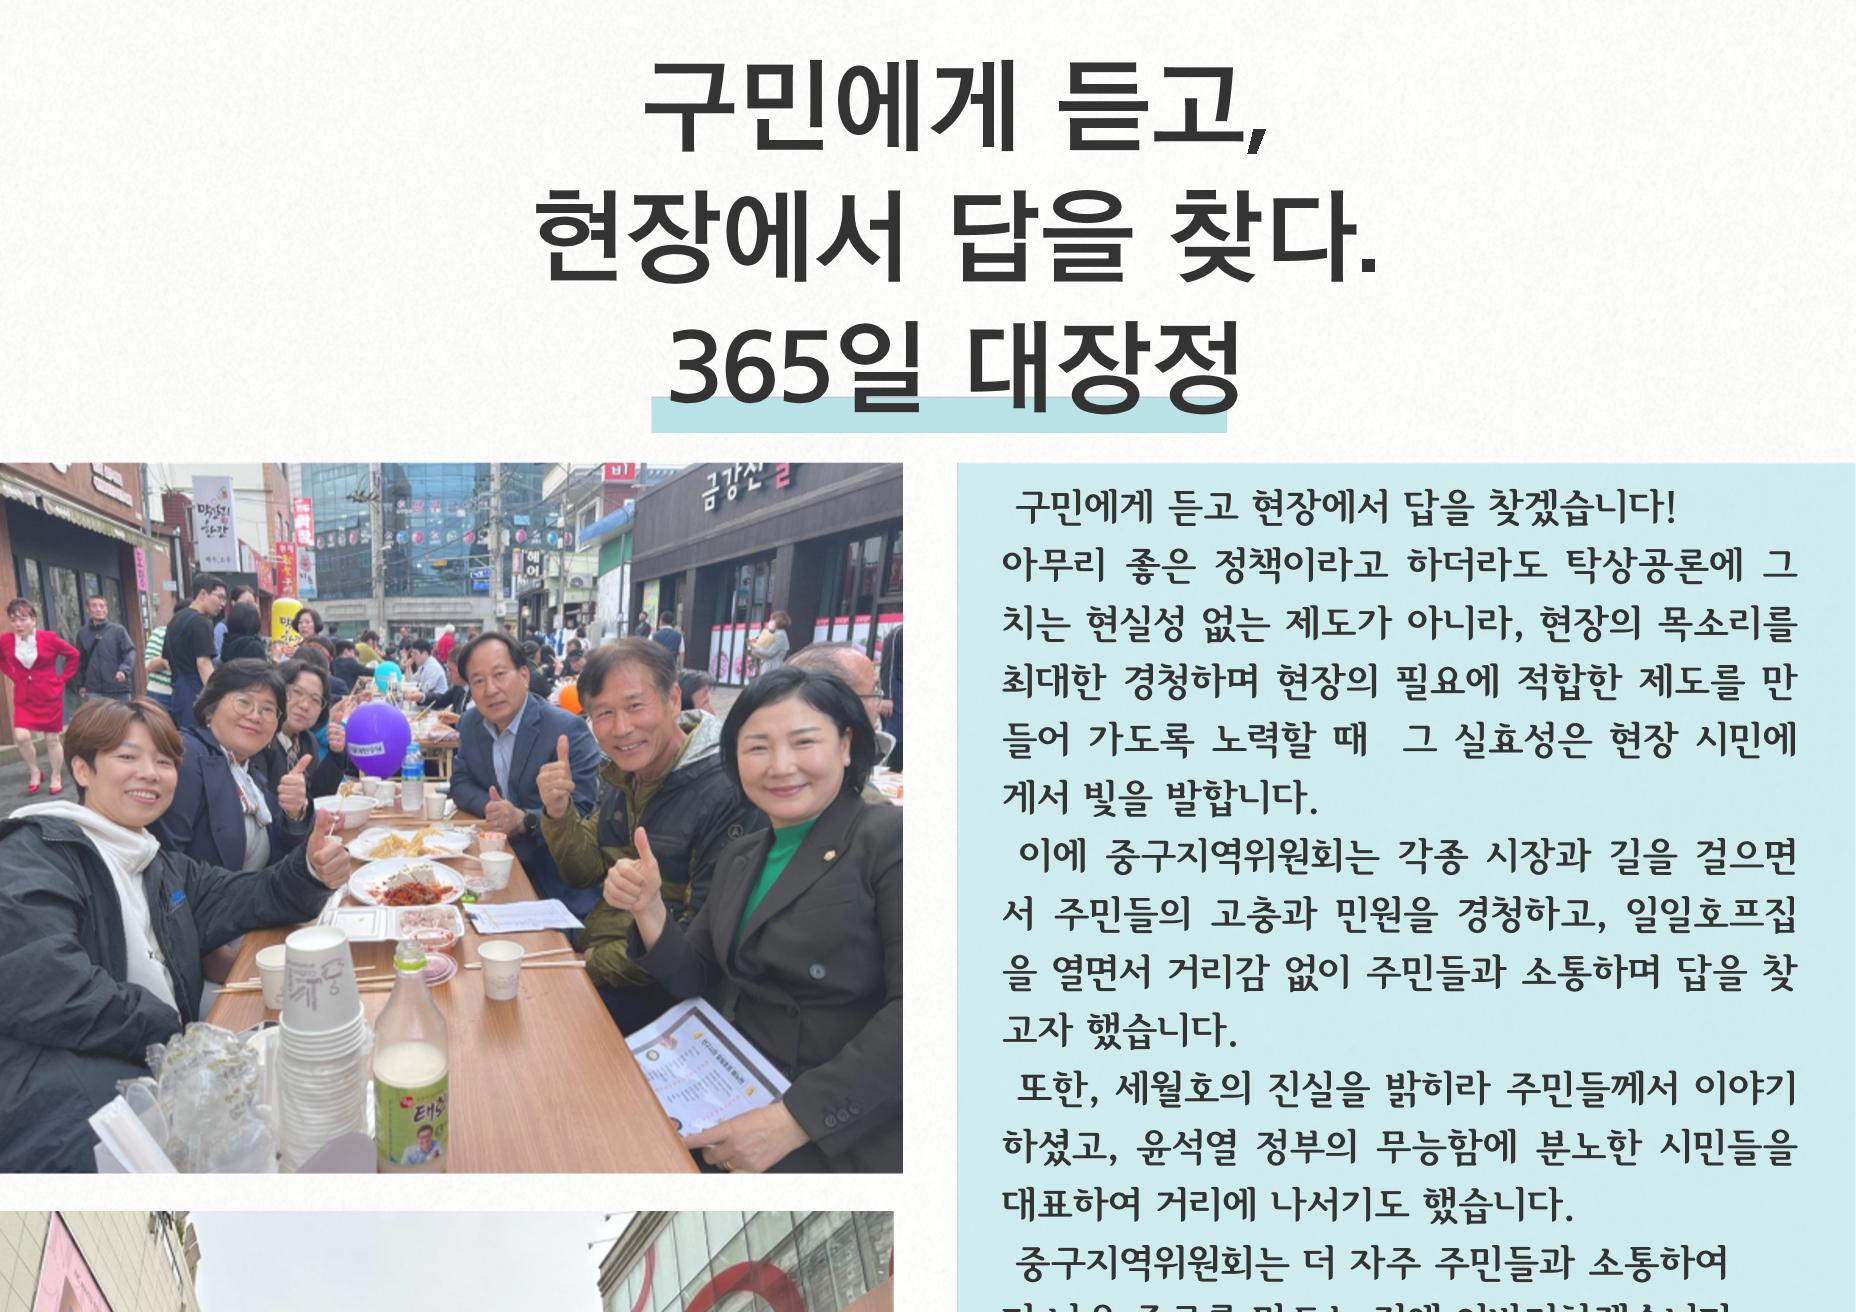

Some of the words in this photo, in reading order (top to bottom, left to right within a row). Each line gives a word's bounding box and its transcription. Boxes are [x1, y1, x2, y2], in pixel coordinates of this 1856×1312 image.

[644, 59, 1014, 152] 구민에게
[1058, 62, 1267, 155] 듣고,
[535, 189, 901, 285] 현장에서
[953, 189, 1133, 282] 답을
[1170, 189, 1376, 283] 찾다.
[670, 320, 920, 413] 365일
[970, 320, 1238, 415] 대장정
[1015, 488, 1153, 527] 구민에게
[1168, 490, 1239, 527] 듣고
[1252, 488, 1388, 527] 현장에서
[1403, 488, 1476, 528] 답을
[1488, 488, 1675, 528] 찾겠습니다!
[1002, 546, 1104, 583] 아무리
[1125, 547, 1197, 586] 좋은
[1215, 546, 1389, 585] 정책이라고
[1406, 546, 1548, 583] 하더라도
[1566, 546, 1742, 585] 탁상공론에
[1762, 550, 1798, 578] 그
[1002, 604, 1072, 643] 치는
[1086, 604, 1184, 643] 현실성
[1202, 604, 1271, 644] 없는
[1285, 604, 1393, 641] 제도가
[1407, 604, 1523, 643] 아니라,
[1539, 604, 1640, 643] 현장의
[1658, 604, 1798, 643] 목소리를
[1002, 662, 1108, 701] 최대한
[1124, 662, 1257, 701] 경청하며
[1276, 662, 1377, 701] 현장의
[1396, 662, 1499, 702] 필요에
[1517, 662, 1623, 702] 적합한
[1639, 662, 1746, 702] 제도를
[1762, 662, 1799, 701] 만
[1002, 721, 1068, 760] 들어
[1089, 721, 1195, 760] 가도록
[1211, 721, 1317, 760] 노력할
[1333, 721, 1367, 757] 때
[1402, 725, 1438, 752] 그
[1455, 721, 1593, 760] 실효성은
[1609, 721, 1680, 760] 현장
[1696, 721, 1796, 759] 시민에
[1003, 779, 1068, 816] 게서
[1083, 779, 1153, 818] 빛을
[1166, 779, 1318, 818] 발합니다.
[1019, 837, 1086, 874] 이에
[1105, 837, 1381, 876] 중구지역위원회는
[1398, 837, 1469, 876] 각종
[1486, 837, 1592, 876] 시장과
[1610, 837, 1678, 876] 길을
[1696, 837, 1796, 876] 걸으면
[1002, 895, 1033, 932] 서
[1054, 895, 1190, 934] 주민들의
[1210, 895, 1319, 934] 고충과
[1335, 895, 1439, 934] 민원을
[1458, 895, 1606, 934] 경청하고,
[1626, 895, 1796, 935] 일일호프집
[1002, 954, 1038, 992] 을
[1052, 953, 1150, 992] 열면서
[1168, 953, 1271, 993] 거리감
[1285, 953, 1349, 993] 없이
[1366, 953, 1508, 992] 주민들과
[1521, 953, 1659, 993] 소통하며
[1676, 953, 1748, 993] 답을
[1762, 953, 1799, 992] 찾
[1002, 1011, 1074, 1048] 고자
[1086, 1011, 1237, 1051] 했습니다.
[1017, 1069, 1098, 1109] 또한,
[1115, 1069, 1250, 1109] 세월호의
[1268, 1069, 1371, 1109] 진실을
[1385, 1069, 1492, 1109] 밝히라
[1506, 1069, 1677, 1109] 주민들께서
[1695, 1069, 1795, 1106] 이야기
[1002, 1128, 1117, 1167] 하셨고,
[1136, 1128, 1237, 1167] 윤석열
[1256, 1128, 1356, 1167] 정부의
[1376, 1128, 1516, 1168] 무능함에
[1535, 1128, 1643, 1167] 분노한
[1660, 1128, 1798, 1167] 시민들을
[1001, 1186, 1140, 1223] 대표하여
[1156, 1186, 1256, 1223] 거리에
[1271, 1186, 1410, 1223] 나서기도
[1422, 1186, 1573, 1226] 했습니다.
[1015, 1244, 1290, 1283] 중구지역위원회는
[1303, 1244, 1334, 1281] 더
[1350, 1244, 1422, 1281] 자주
[1434, 1244, 1576, 1283] 주민들과
[1588, 1244, 1726, 1284] 소통하여
